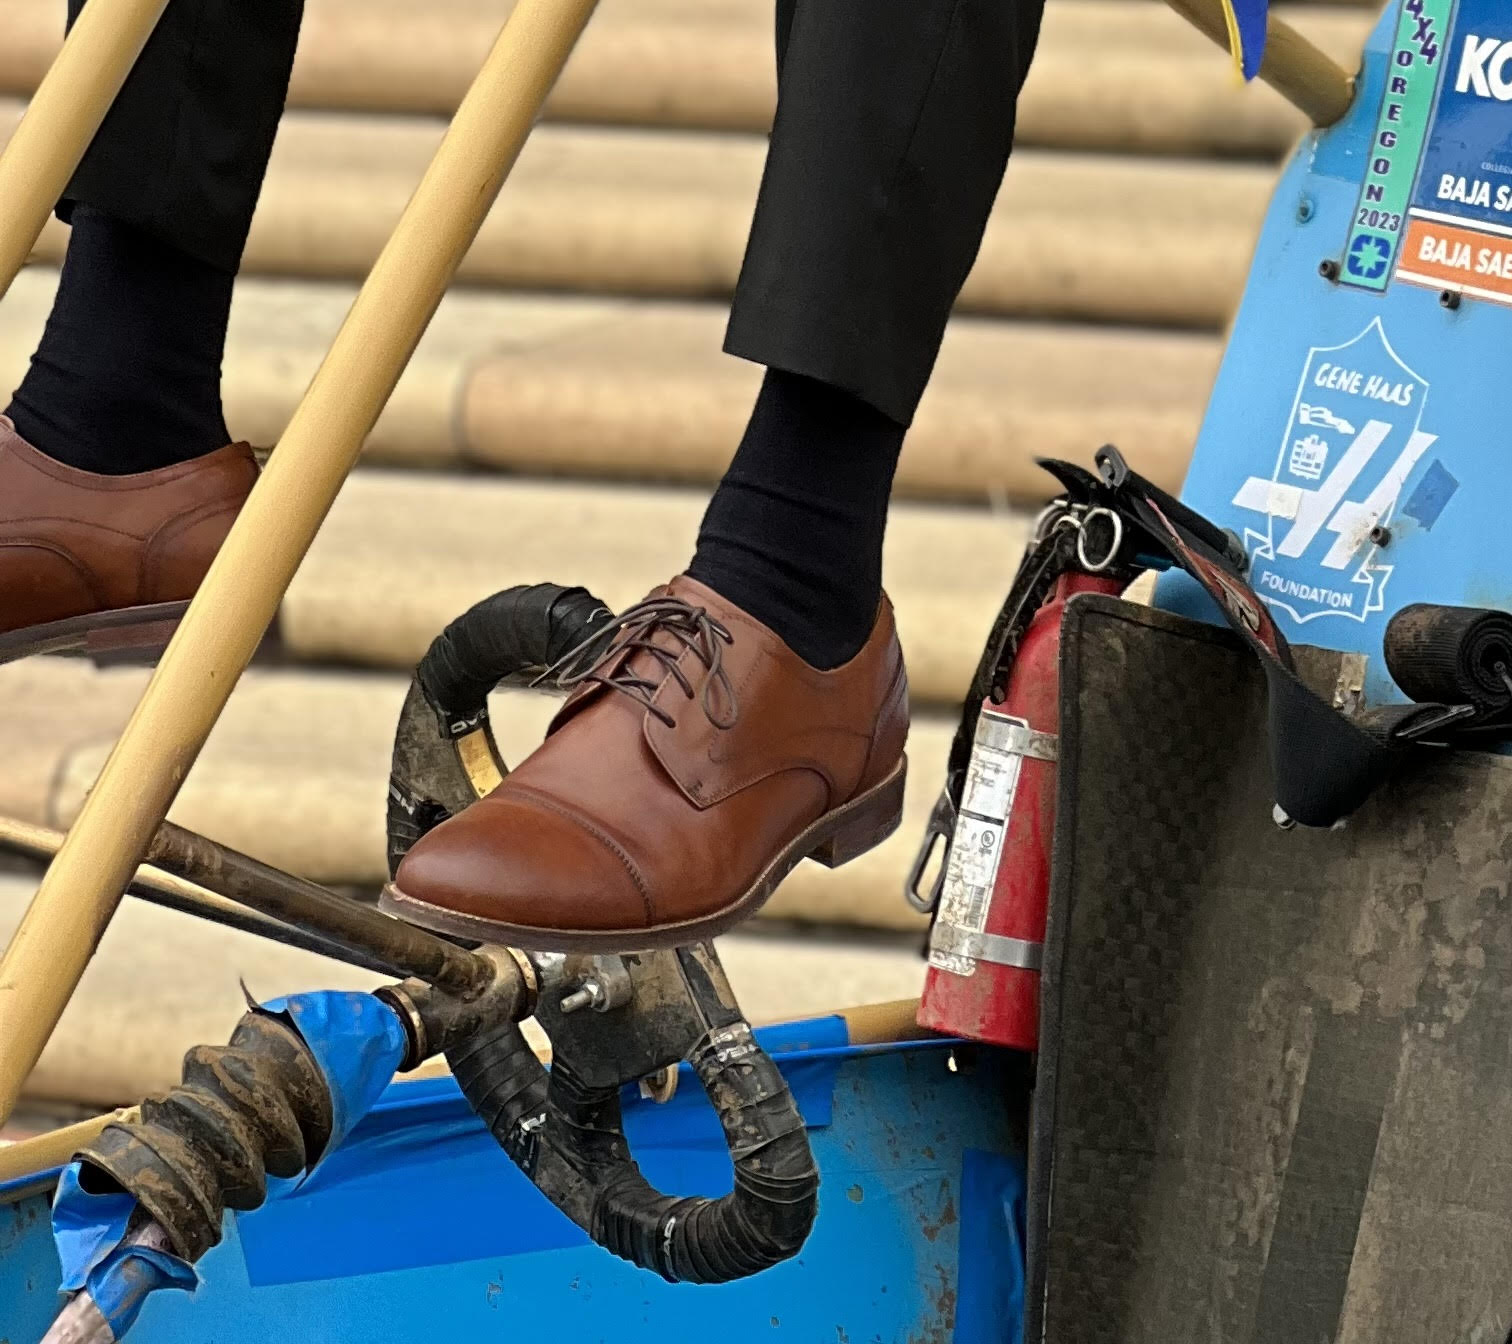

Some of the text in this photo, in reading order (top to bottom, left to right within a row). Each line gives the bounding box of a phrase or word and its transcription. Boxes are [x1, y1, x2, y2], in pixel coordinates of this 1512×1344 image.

[1365, 50, 1414, 203] OREGON
[1436, 174, 1492, 208] BAJA
[1357, 208, 1401, 232] 2023
[1418, 235, 1473, 271] BAJA
[1314, 362, 1414, 407] GENE HAAS
[1260, 570, 1354, 608] FOUNDATION
